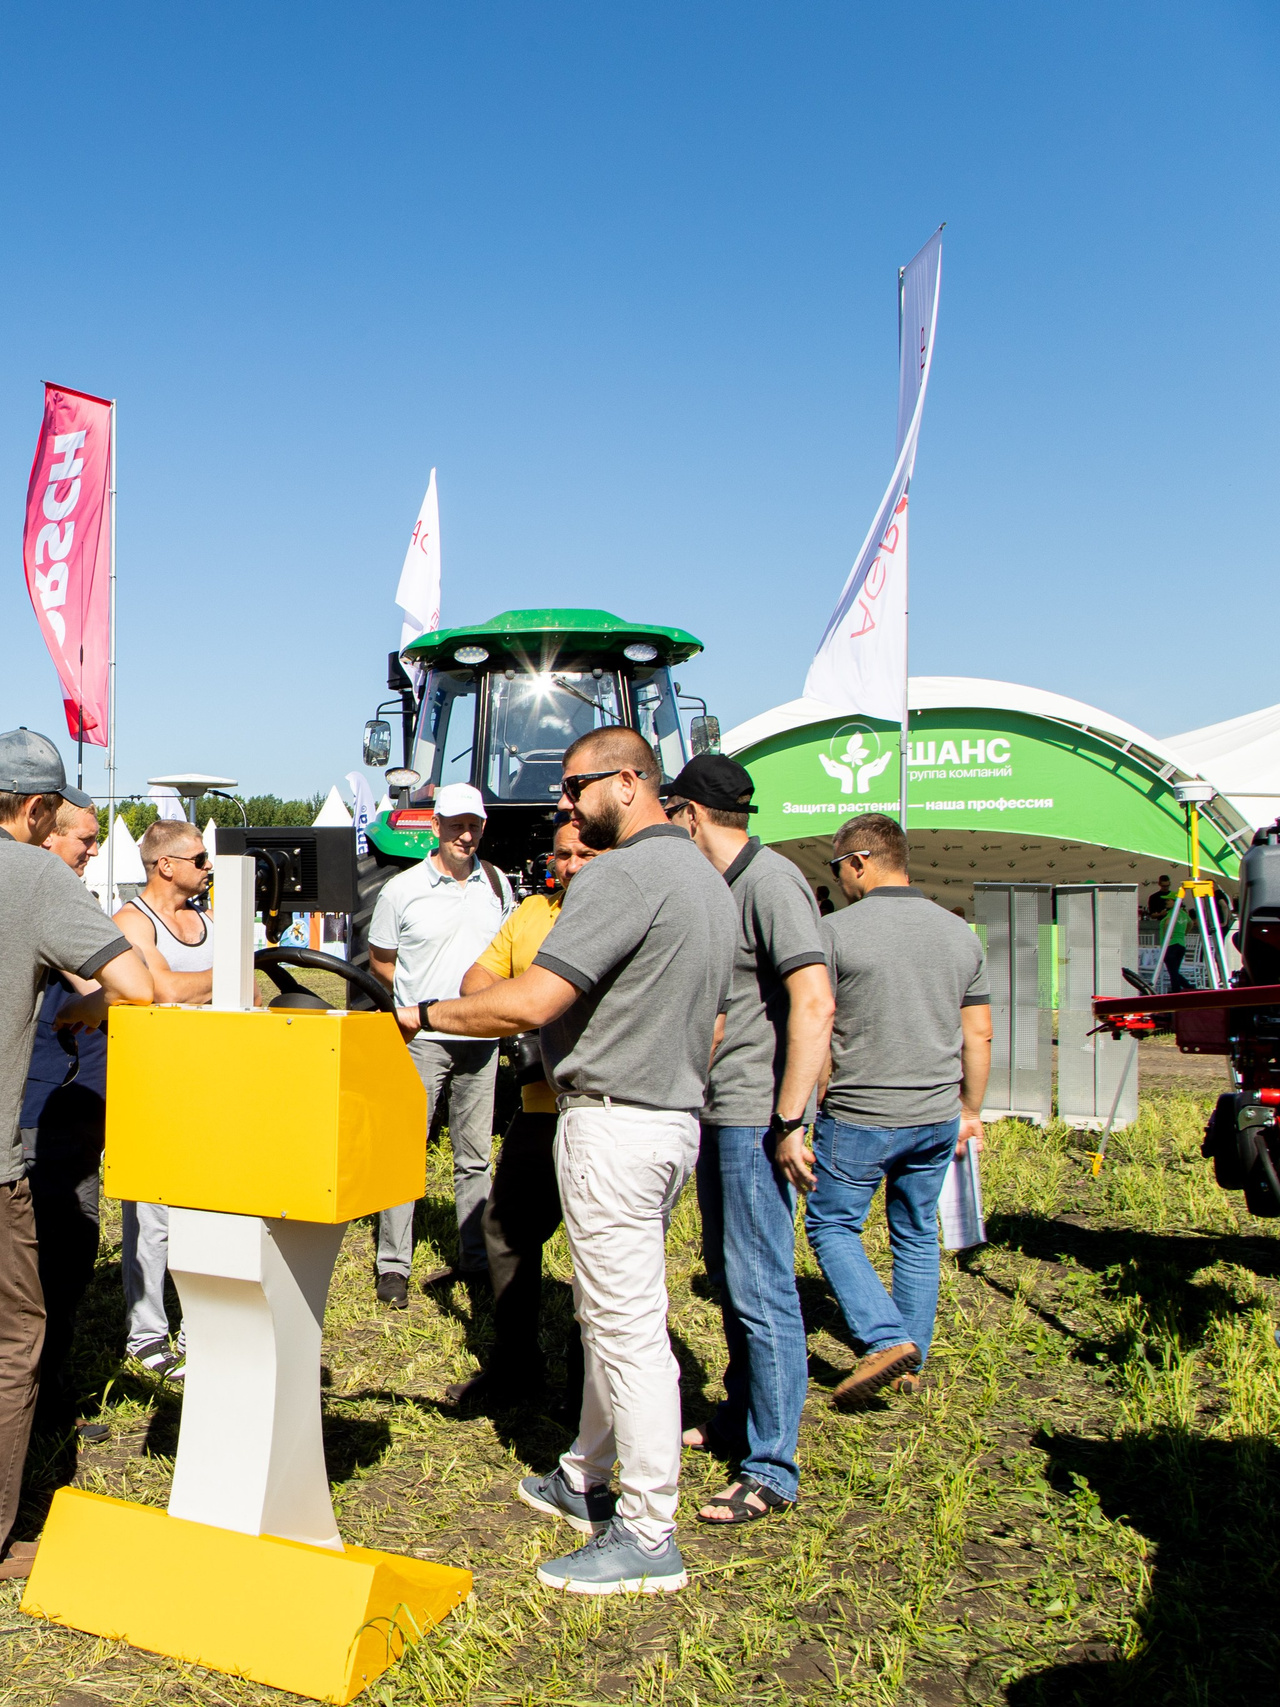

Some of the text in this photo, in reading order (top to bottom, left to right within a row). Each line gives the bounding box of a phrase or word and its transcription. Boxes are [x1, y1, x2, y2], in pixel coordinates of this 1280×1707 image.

[907, 738, 1011, 766] ШАНС
[949, 765, 1012, 779] компаний
[782, 802, 835, 815] Защита
[925, 800, 965, 811] наша
[967, 797, 1053, 812] профессия
